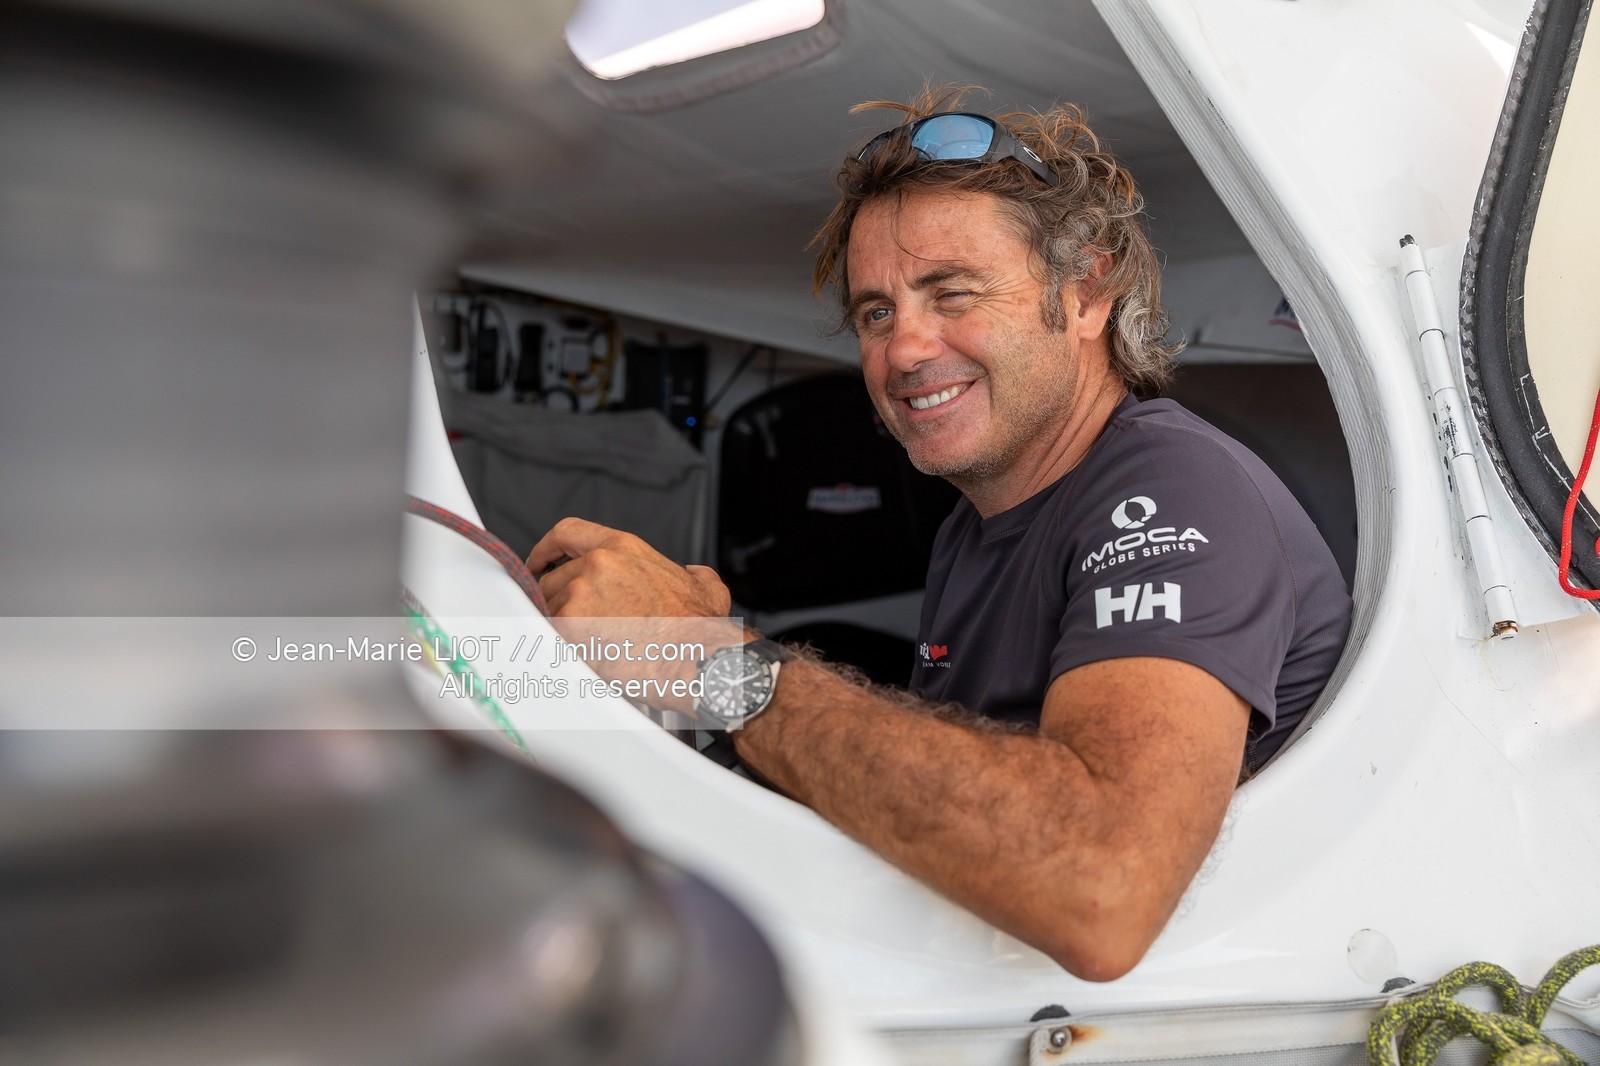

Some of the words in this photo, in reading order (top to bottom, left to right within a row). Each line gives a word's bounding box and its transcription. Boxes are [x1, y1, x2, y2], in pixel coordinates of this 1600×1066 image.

[1081, 527, 1209, 572] IMOCA
[1093, 551, 1136, 574] GLOBE
[1142, 542, 1196, 558] SERIES
